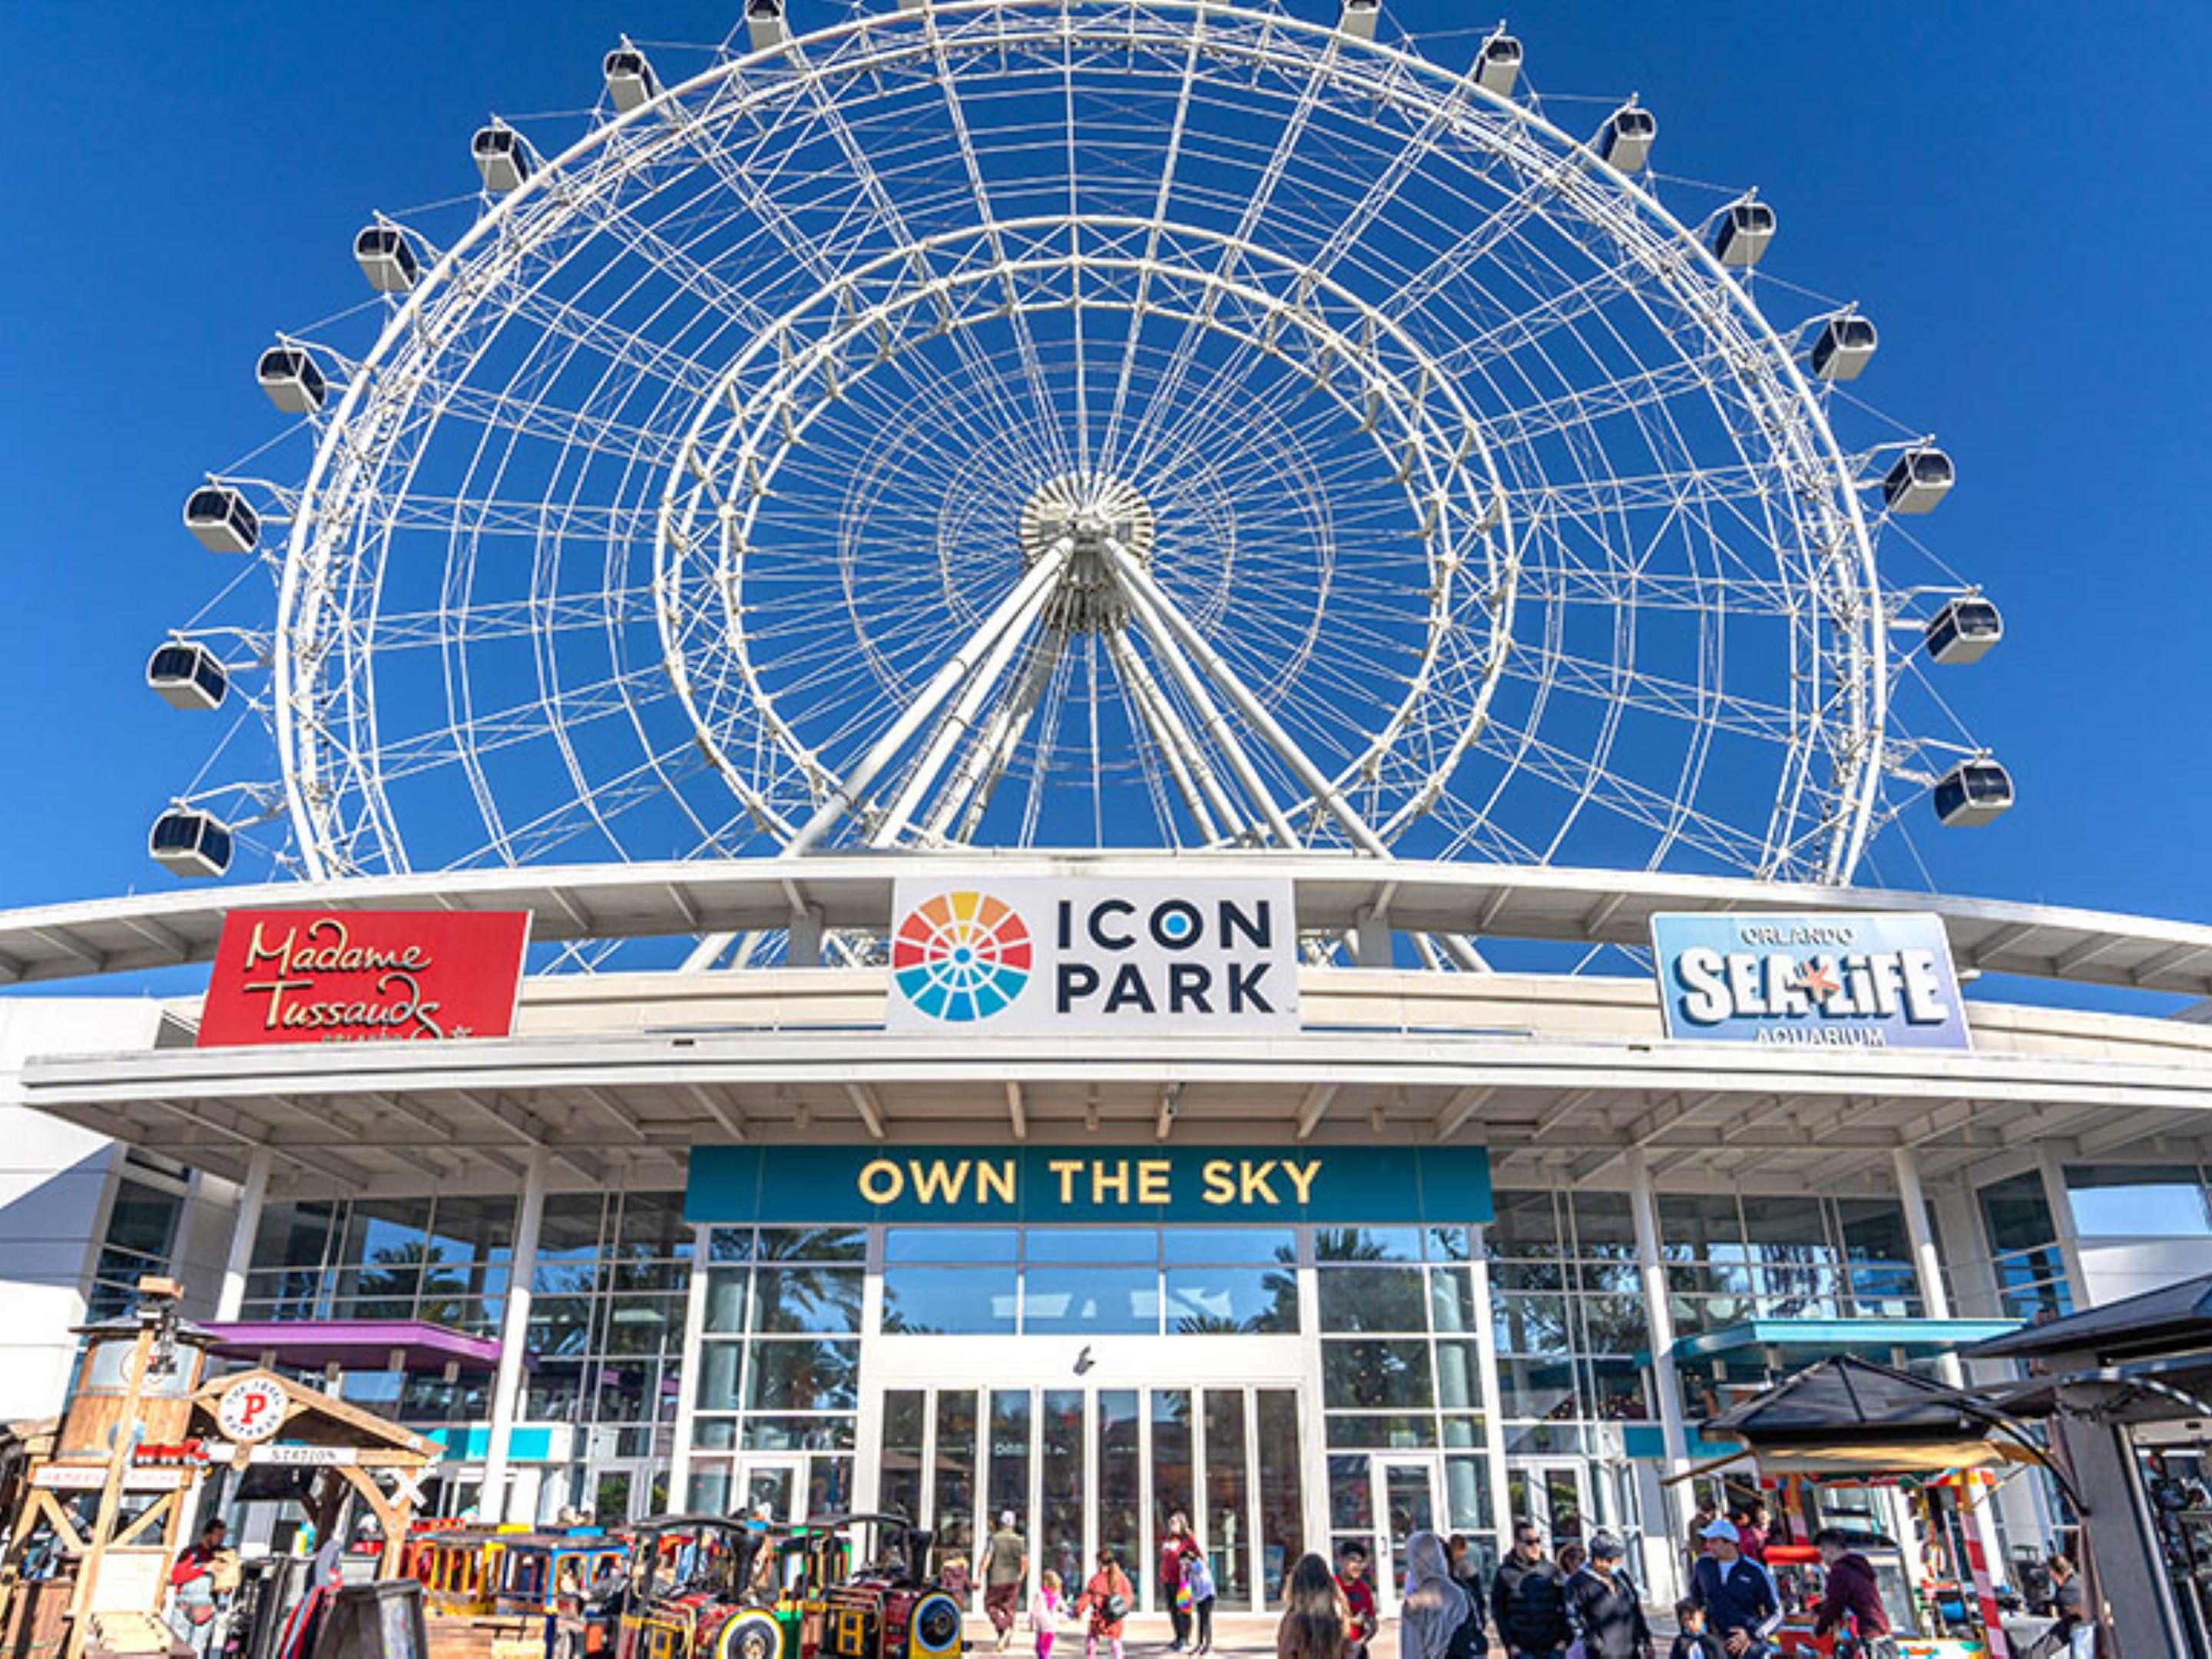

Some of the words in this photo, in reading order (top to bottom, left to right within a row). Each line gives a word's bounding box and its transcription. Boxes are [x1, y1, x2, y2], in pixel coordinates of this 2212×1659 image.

[244, 918, 432, 978] Madame
[1057, 899, 1272, 951] ICON
[1740, 927, 1854, 946] ORLANDO
[243, 972, 444, 1041] Tussauds
[1055, 962, 1276, 1014] PARK
[1677, 946, 1809, 1025] SEA
[1753, 1026, 1886, 1048] AQUARIUM
[857, 1159, 1016, 1205] OWN
[1049, 1159, 1172, 1205] THE
[1201, 1158, 1323, 1205] SKY
[240, 1392, 267, 1426] P
